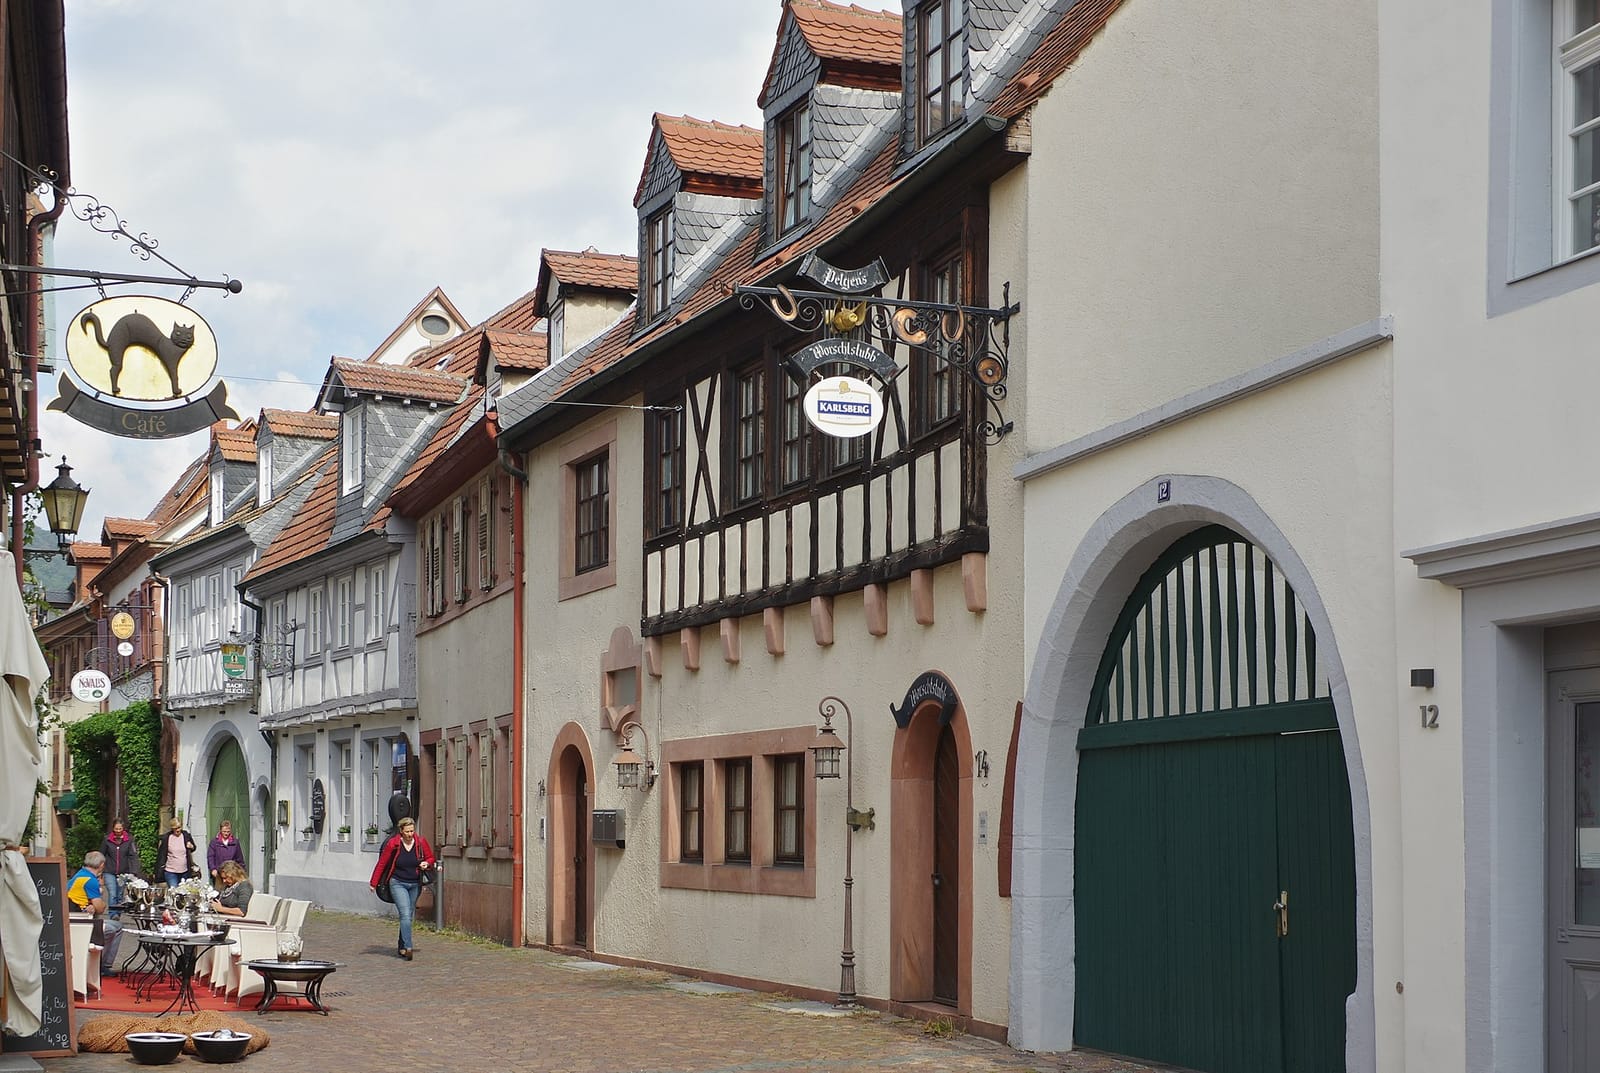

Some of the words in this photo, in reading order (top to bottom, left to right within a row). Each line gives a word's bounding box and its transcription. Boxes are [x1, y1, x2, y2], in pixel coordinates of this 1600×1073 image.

[820, 402, 869, 414] KARLSBERG
[121, 412, 168, 433] Café
[1159, 482, 1168, 499] 12
[1419, 704, 1440, 728] 12
[975, 749, 989, 778] 14
